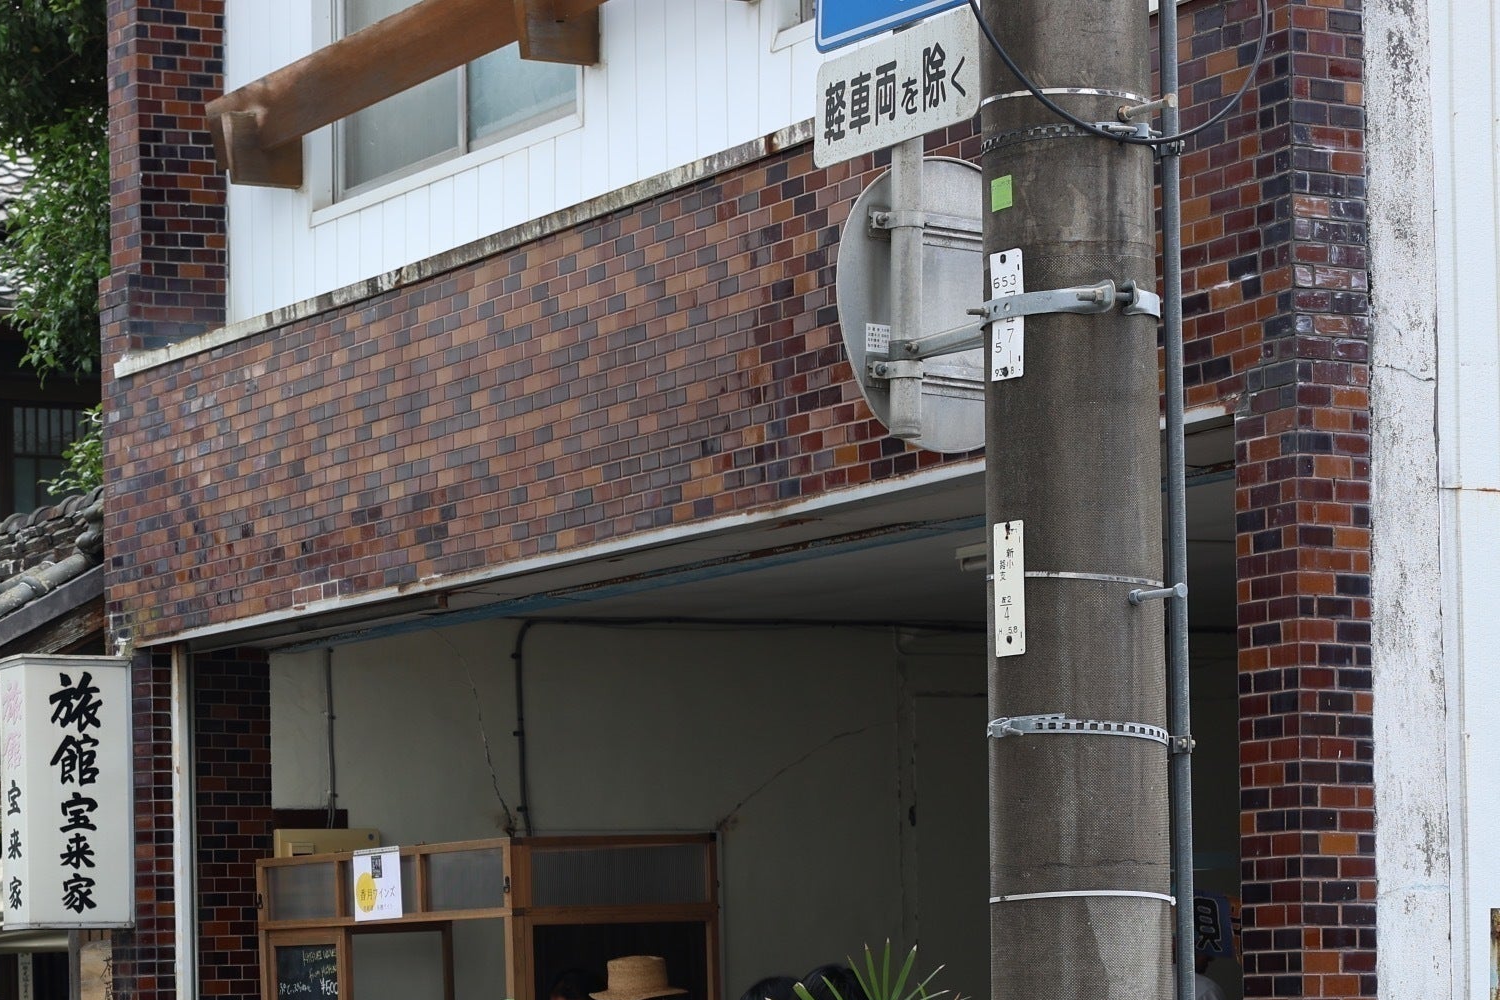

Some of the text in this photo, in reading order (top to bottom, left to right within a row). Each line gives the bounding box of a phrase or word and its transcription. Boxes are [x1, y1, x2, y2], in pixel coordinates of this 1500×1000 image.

[824, 42, 966, 146] 軽車両を除く
[993, 274, 1016, 289] 653
[49, 671, 102, 914] 旅館宝来家
